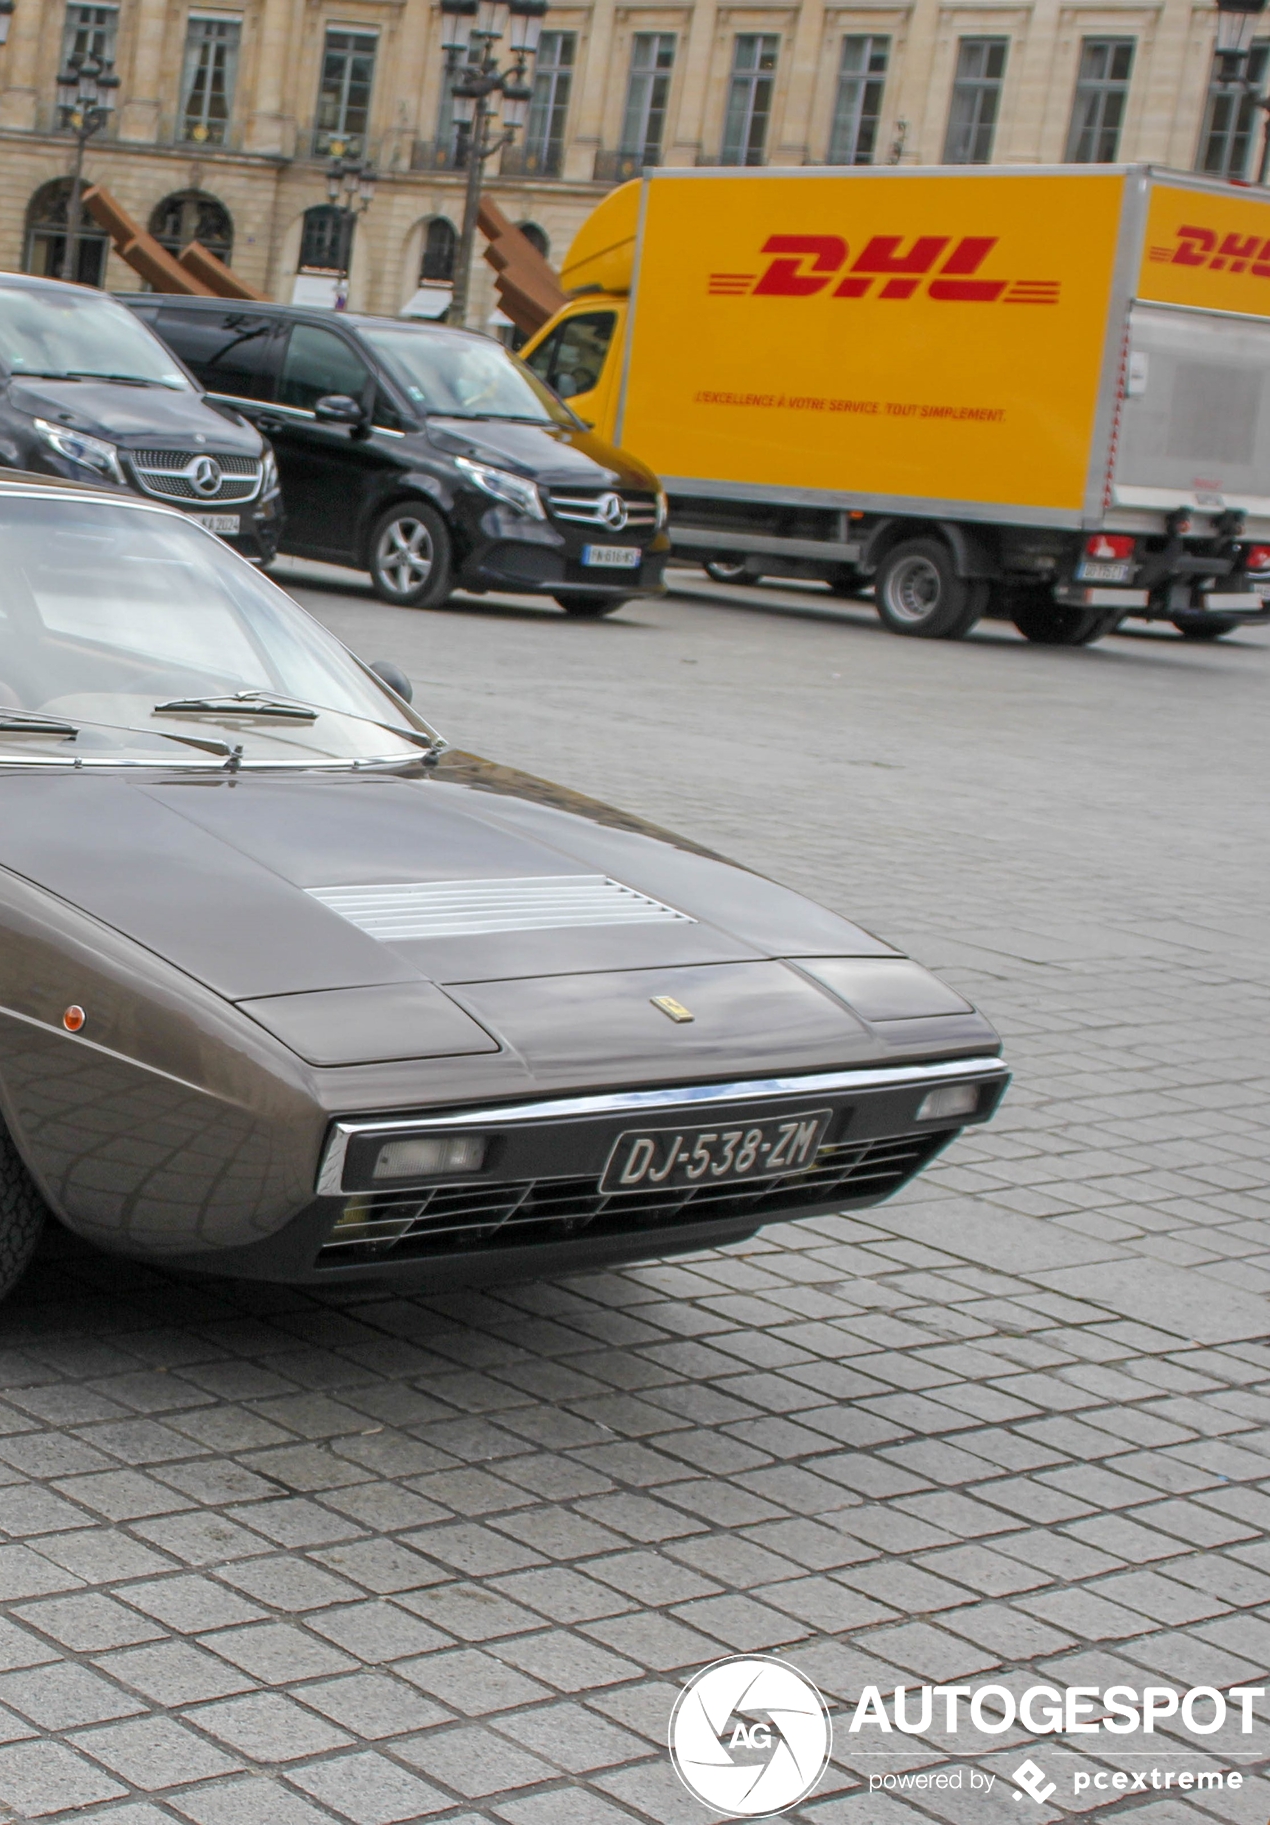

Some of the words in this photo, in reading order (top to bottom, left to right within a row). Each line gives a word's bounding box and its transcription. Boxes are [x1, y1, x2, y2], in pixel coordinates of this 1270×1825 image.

[751, 234, 1009, 302] DHL
[694, 390, 773, 407] L'EXCELLENCE
[788, 396, 826, 410] VOTRE
[885, 402, 918, 416] TOUT
[919, 404, 1007, 423] SIMPLEMENT.
[620, 1119, 818, 1184] DJ-538-ZM
